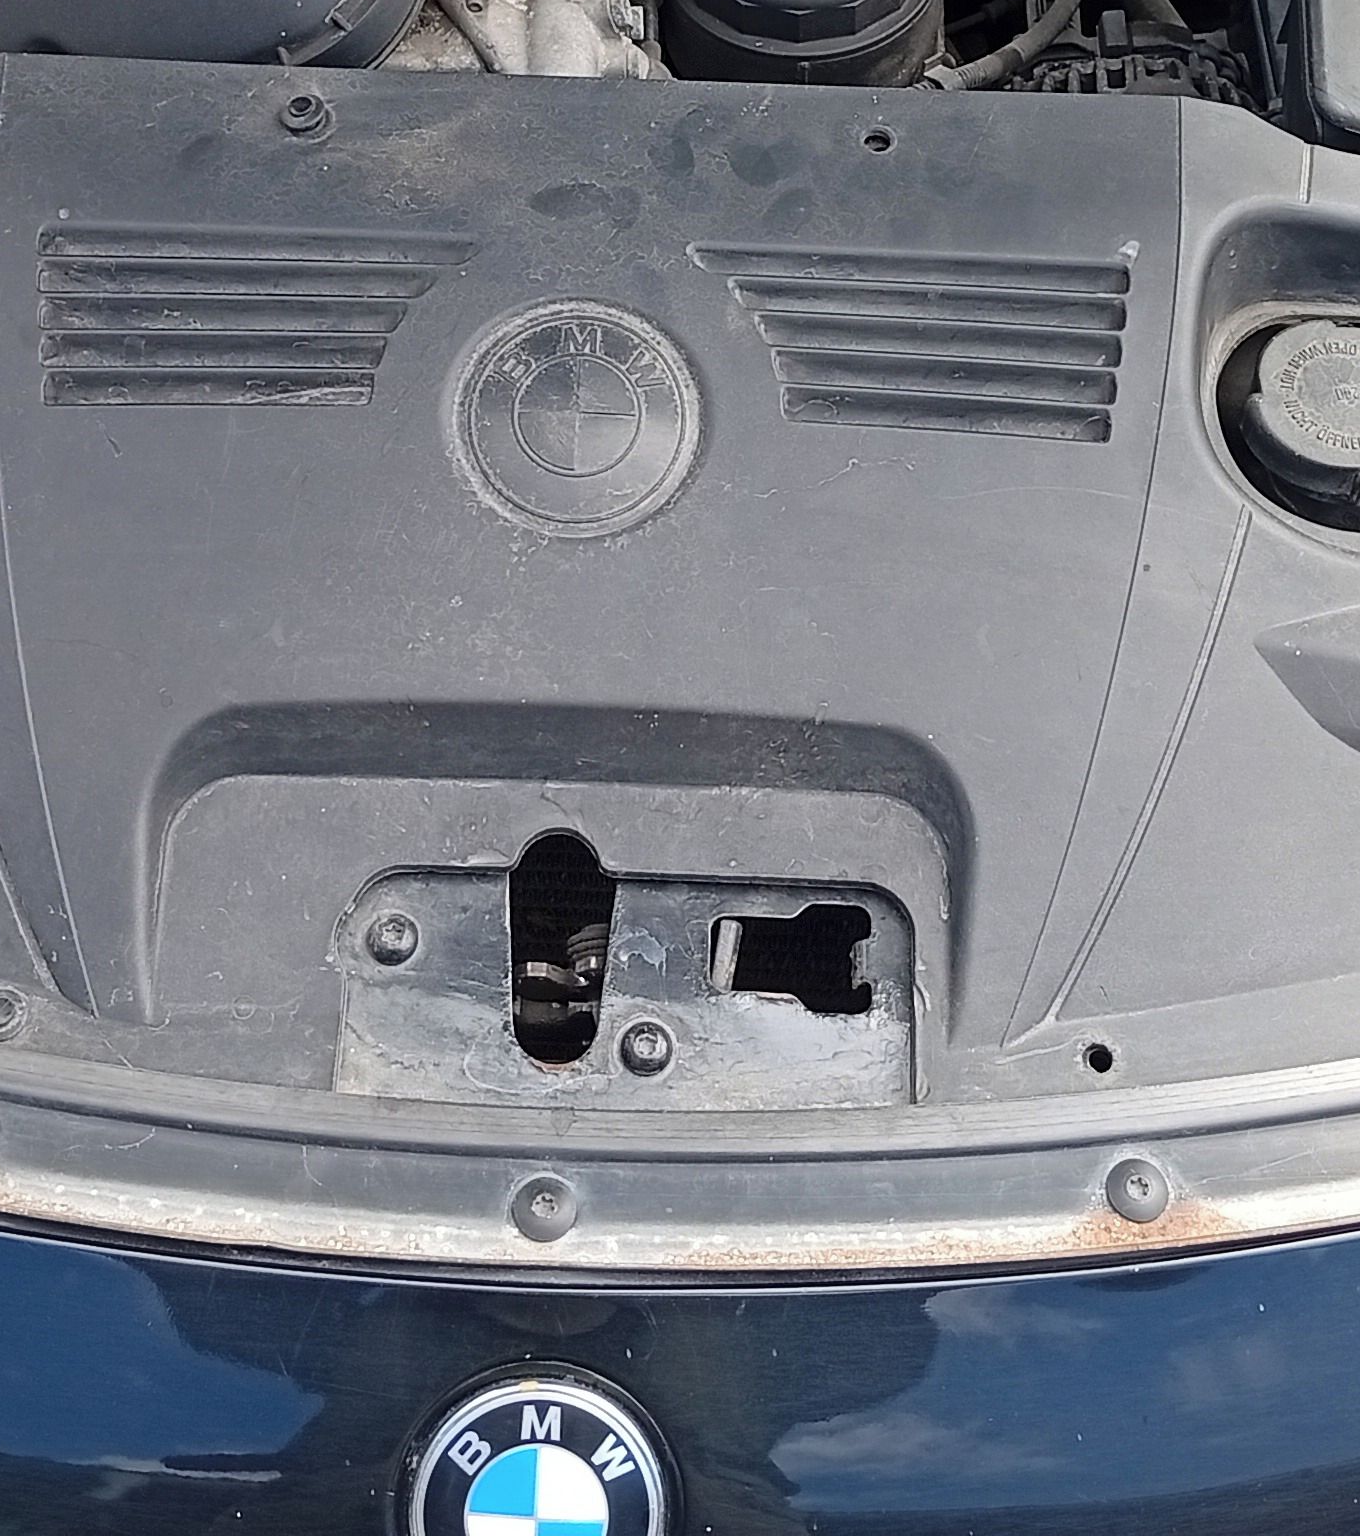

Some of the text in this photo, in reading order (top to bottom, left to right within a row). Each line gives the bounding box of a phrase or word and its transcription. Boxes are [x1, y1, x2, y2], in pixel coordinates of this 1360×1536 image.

[490, 322, 668, 391] BMW
[1323, 342, 1358, 356] OPEN
[1279, 368, 1295, 392] HOT
[1283, 398, 1318, 433] NICHT
[447, 1403, 636, 1482] BMW
